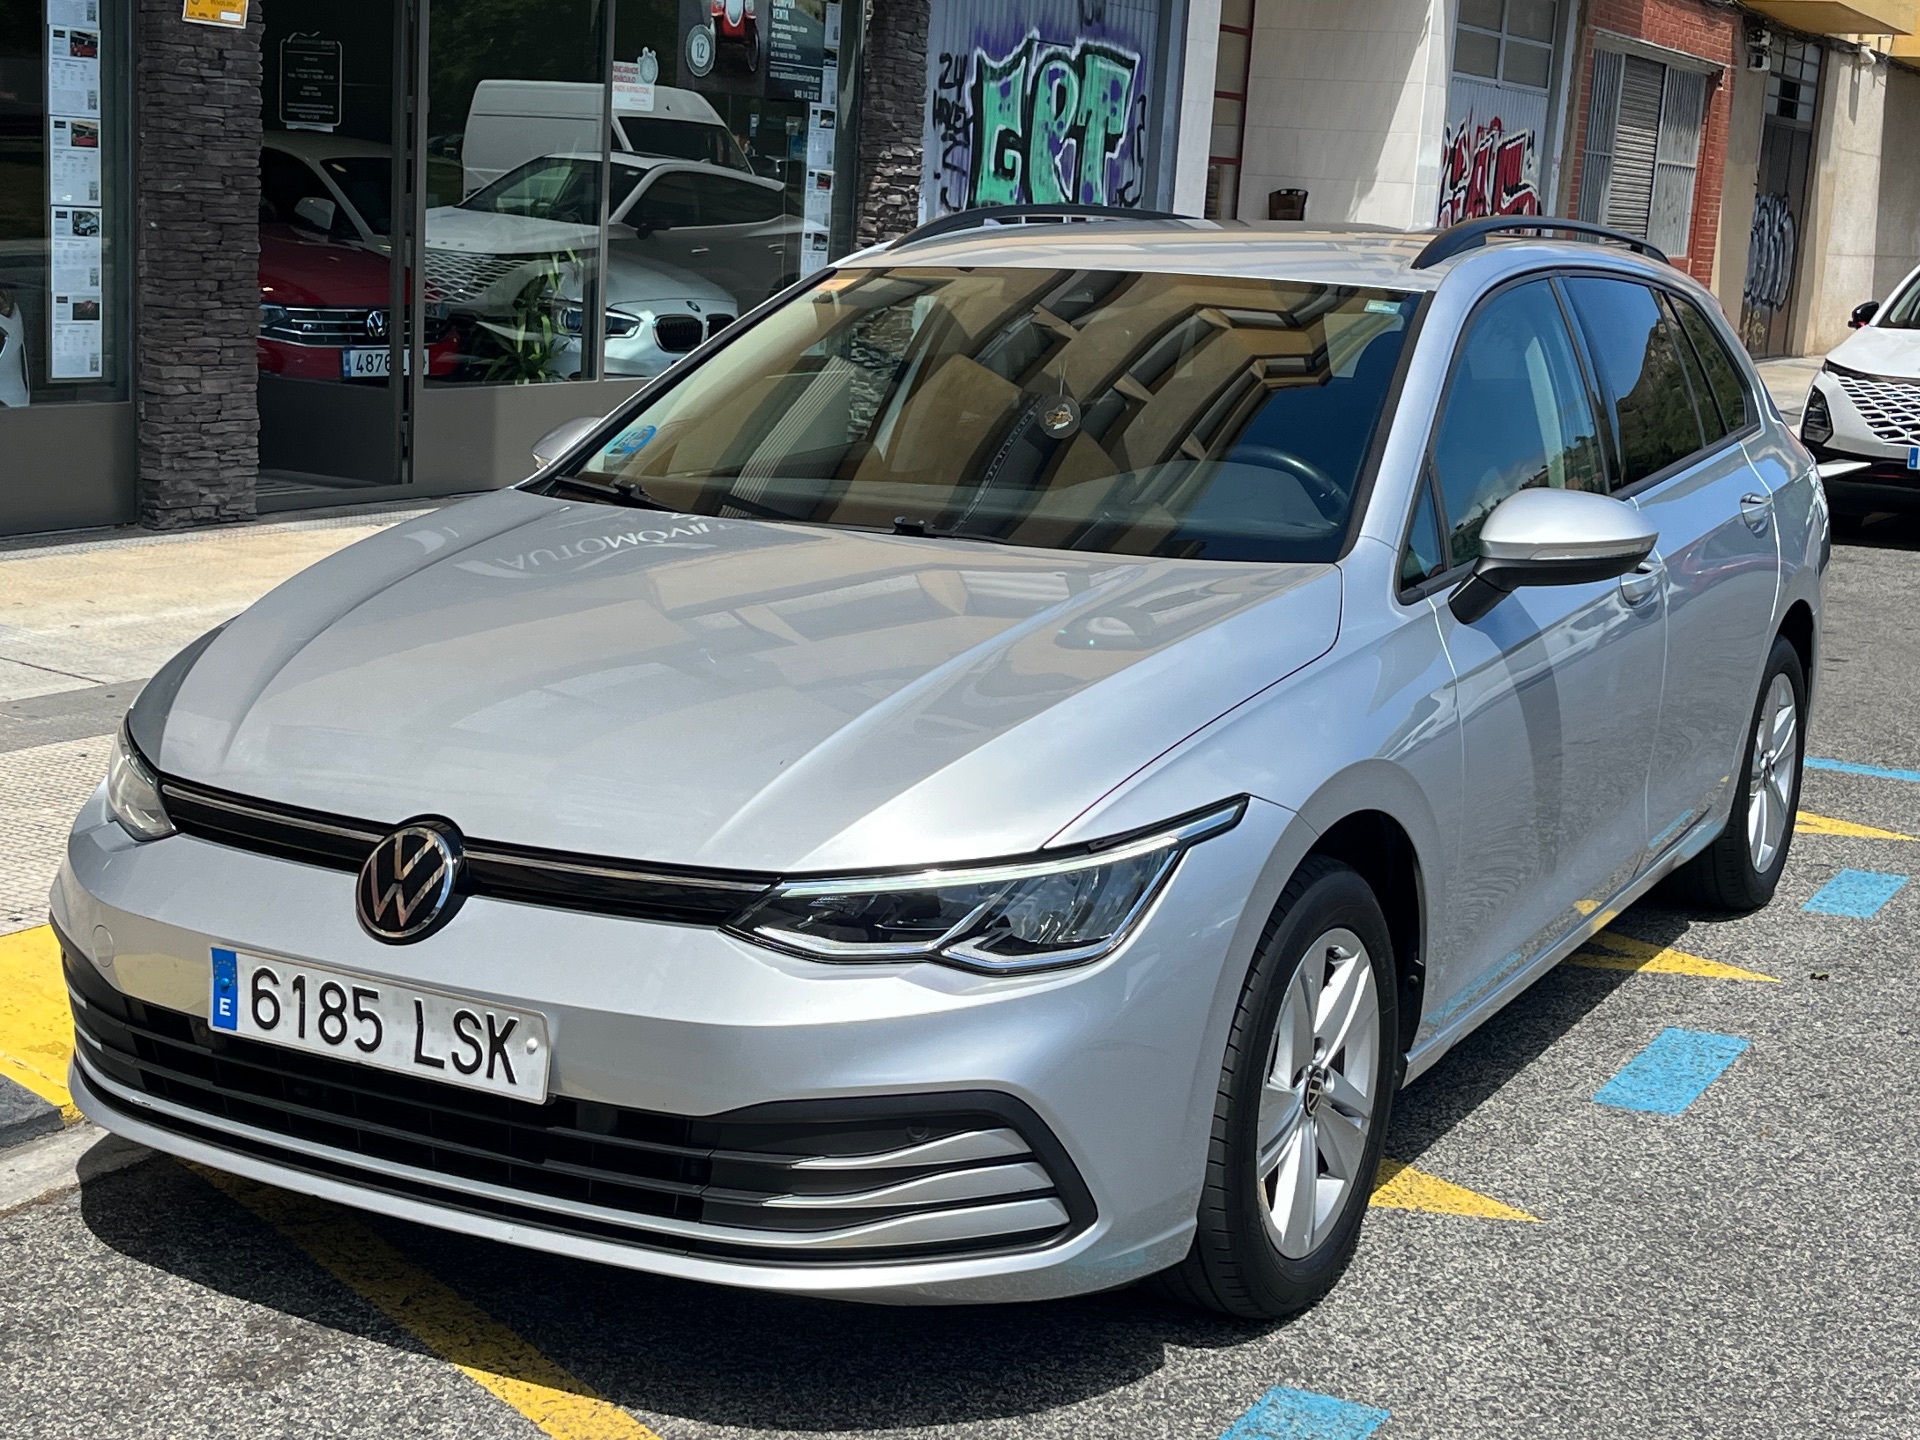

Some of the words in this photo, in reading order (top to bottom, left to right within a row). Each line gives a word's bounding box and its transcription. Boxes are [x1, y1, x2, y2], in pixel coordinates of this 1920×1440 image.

[696, 42, 704, 58] 12
[219, 997, 231, 1017] E
[250, 966, 383, 1054] 6185
[413, 998, 518, 1085] LSK
